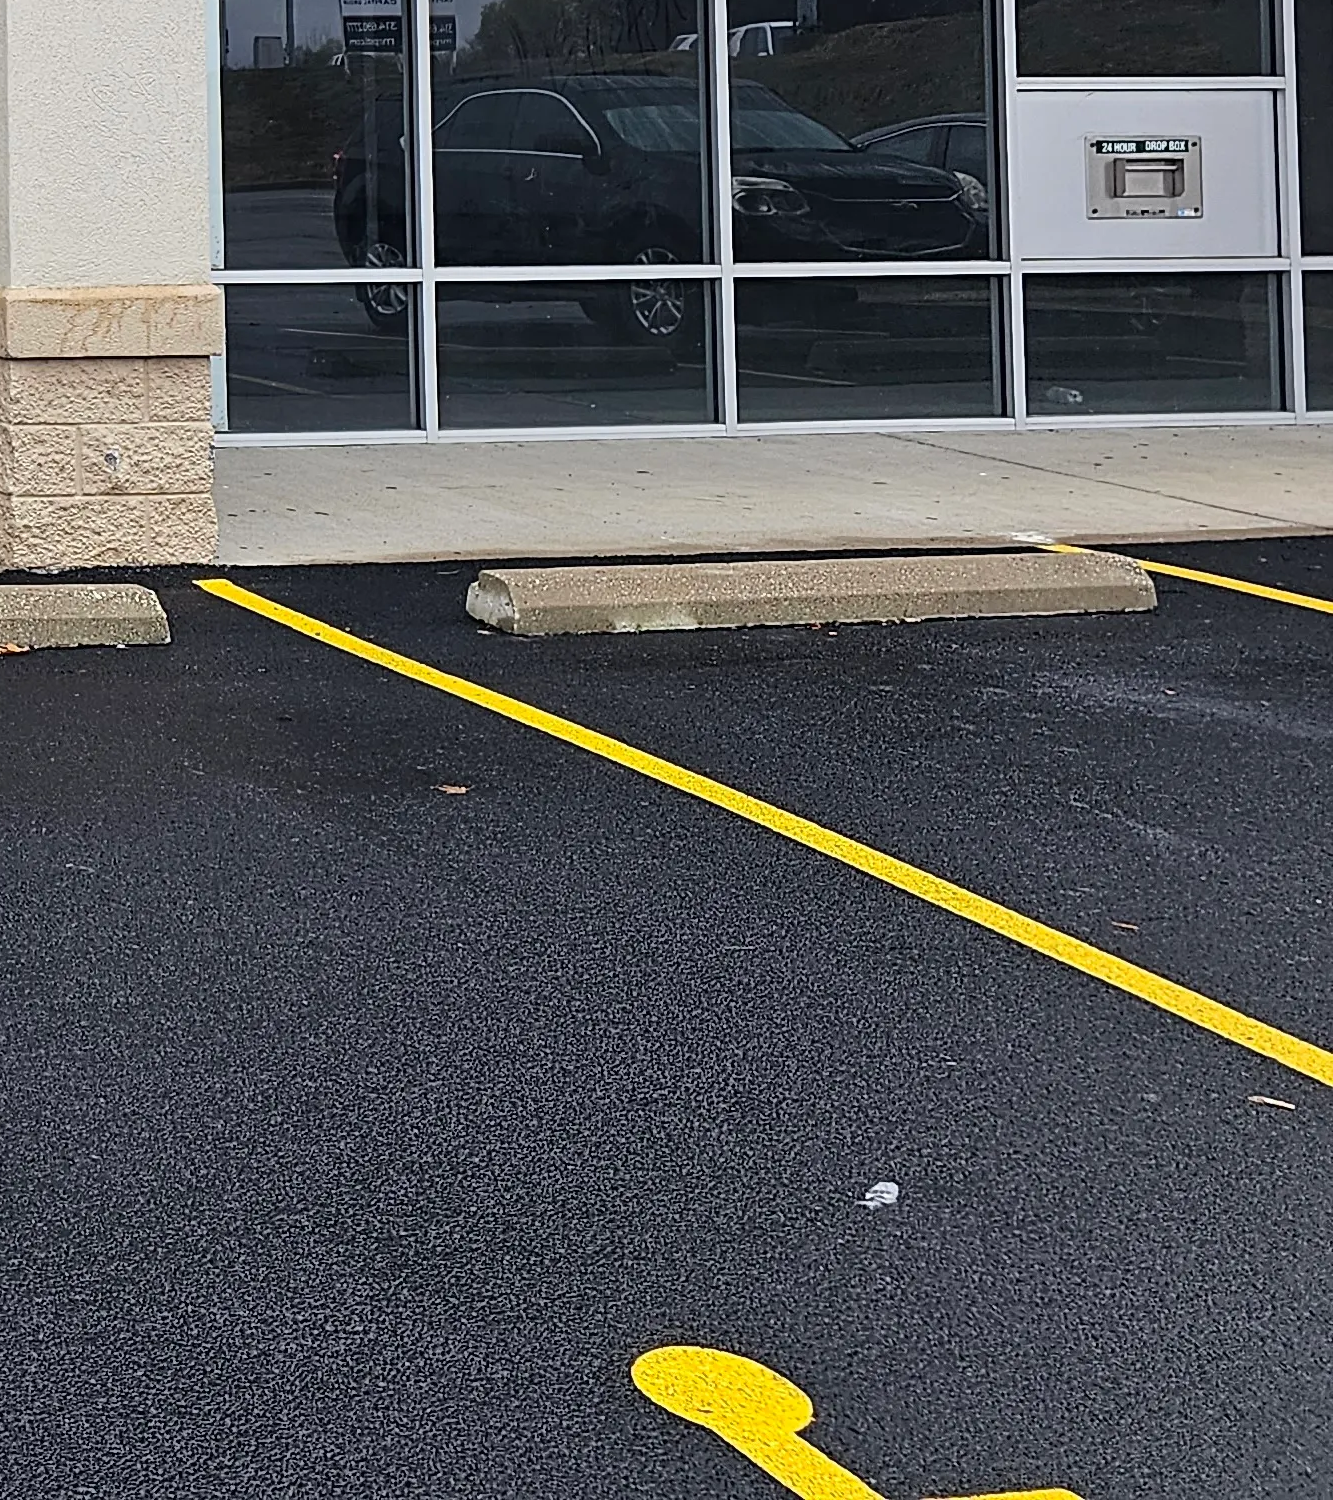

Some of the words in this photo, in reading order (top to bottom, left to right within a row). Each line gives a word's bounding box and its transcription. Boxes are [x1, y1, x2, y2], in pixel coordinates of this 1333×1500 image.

[1102, 143, 1113, 153] 24
[1114, 142, 1137, 152] HOUR
[1145, 141, 1168, 151] DROP
[1168, 141, 1186, 151] BOX
